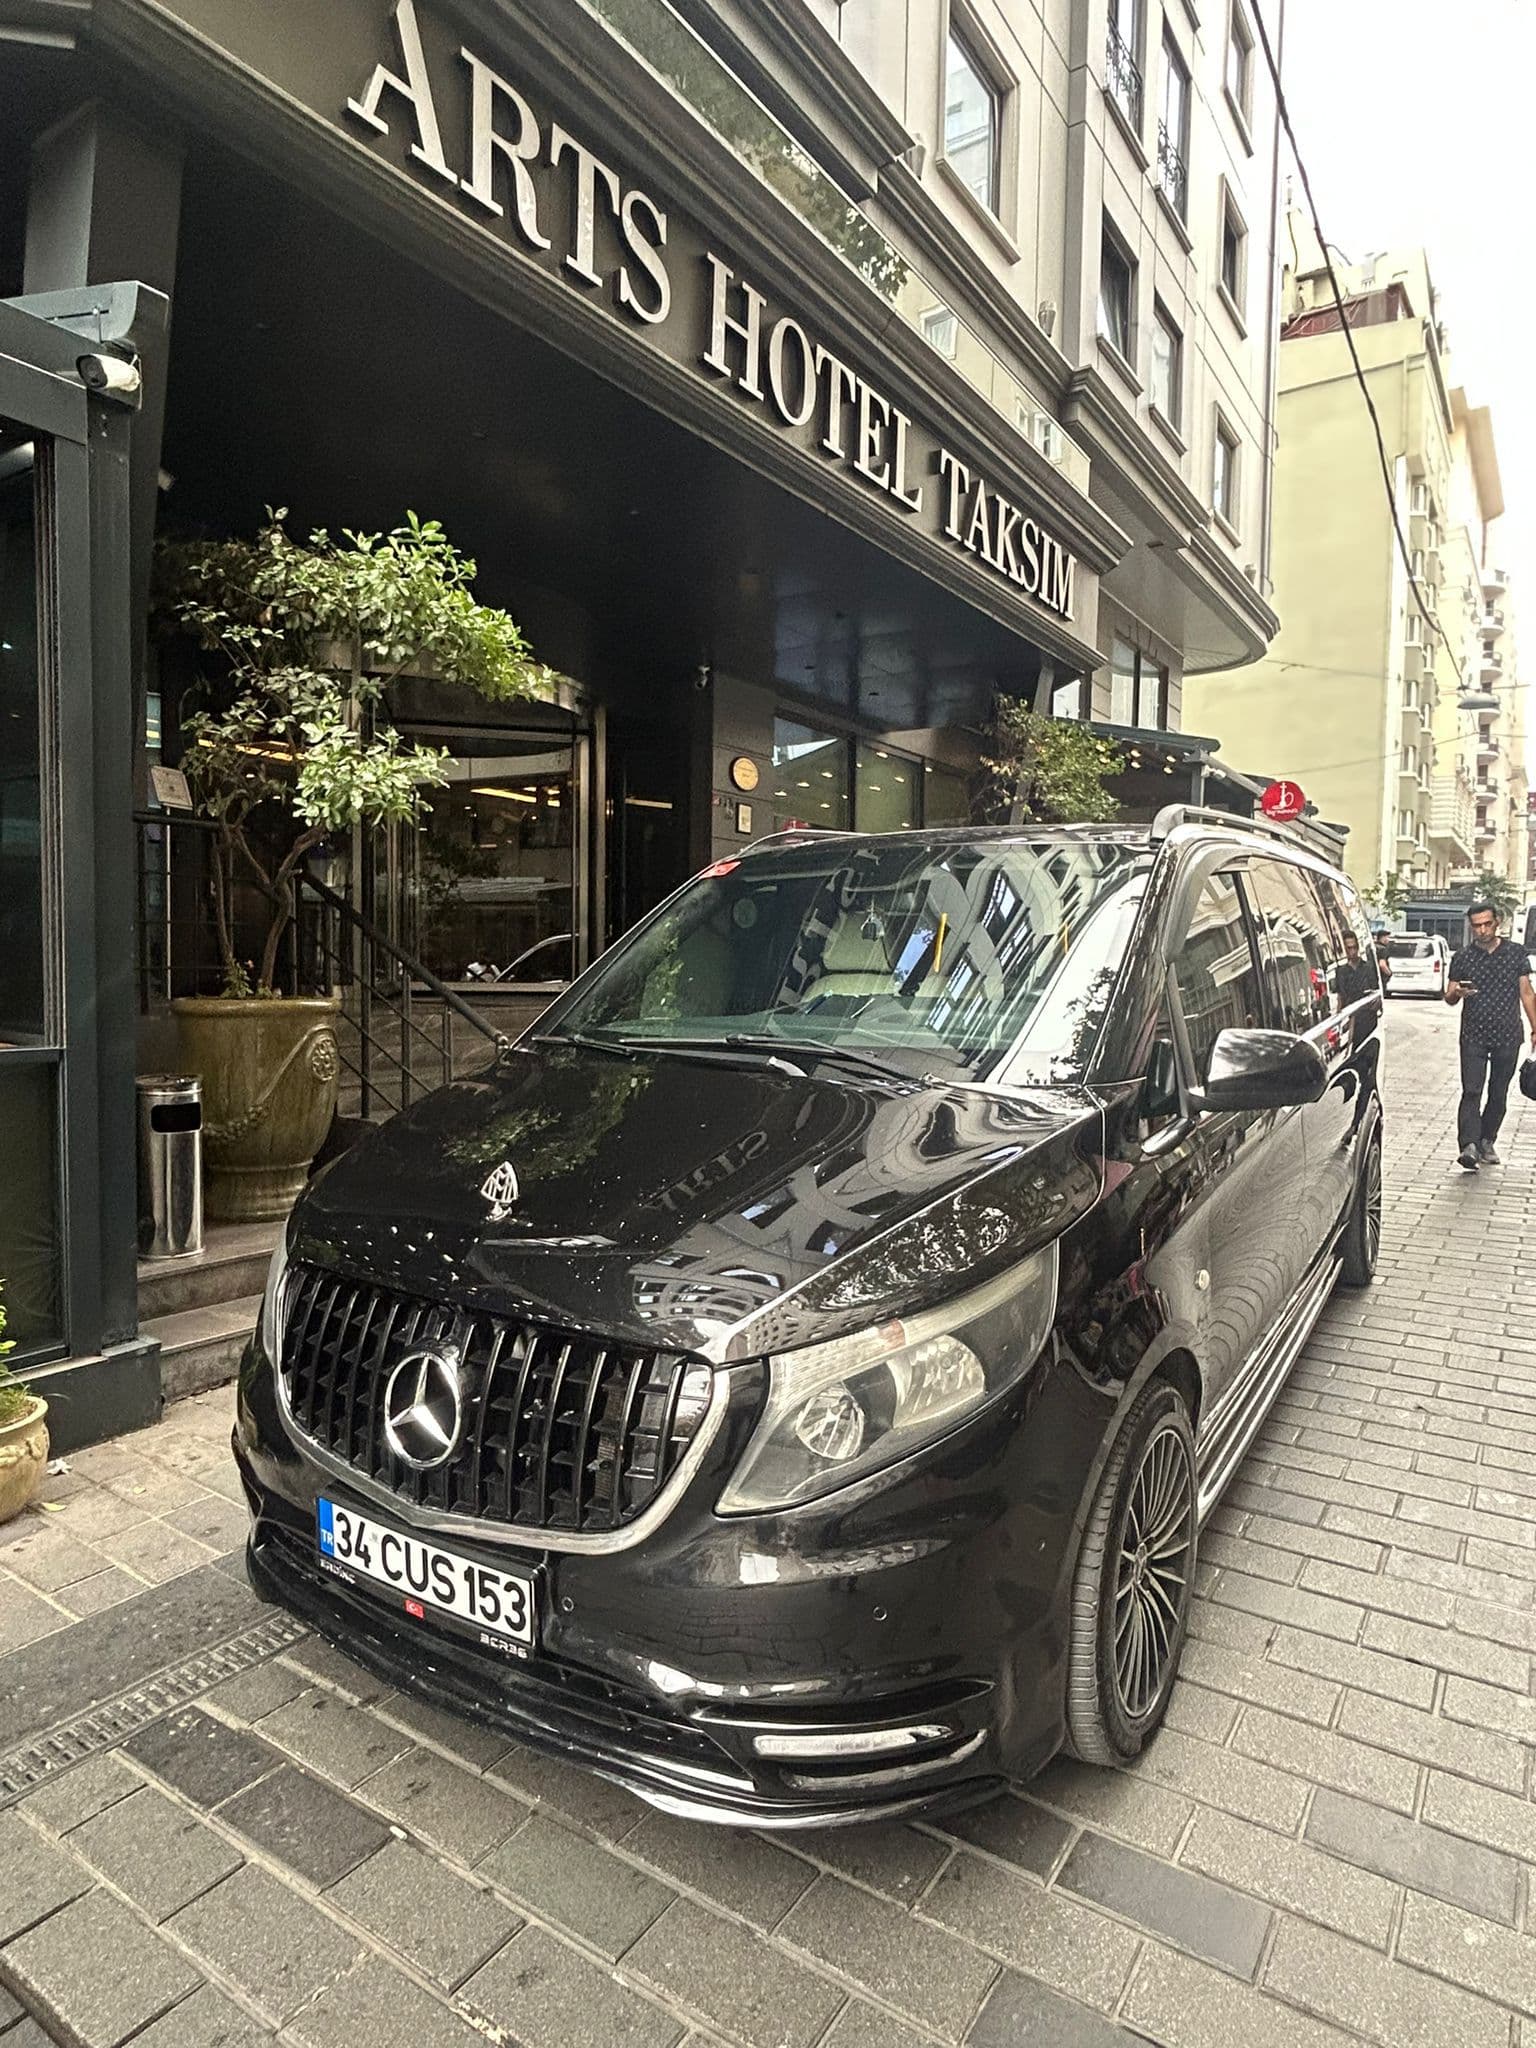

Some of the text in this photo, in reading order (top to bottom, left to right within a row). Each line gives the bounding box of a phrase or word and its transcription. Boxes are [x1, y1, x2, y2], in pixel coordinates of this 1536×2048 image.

[347, 0, 1077, 623] ARTS HOTEL TAKSIM
[321, 1528, 334, 1547] TR
[336, 1512, 527, 1632] 34 CUS 153
